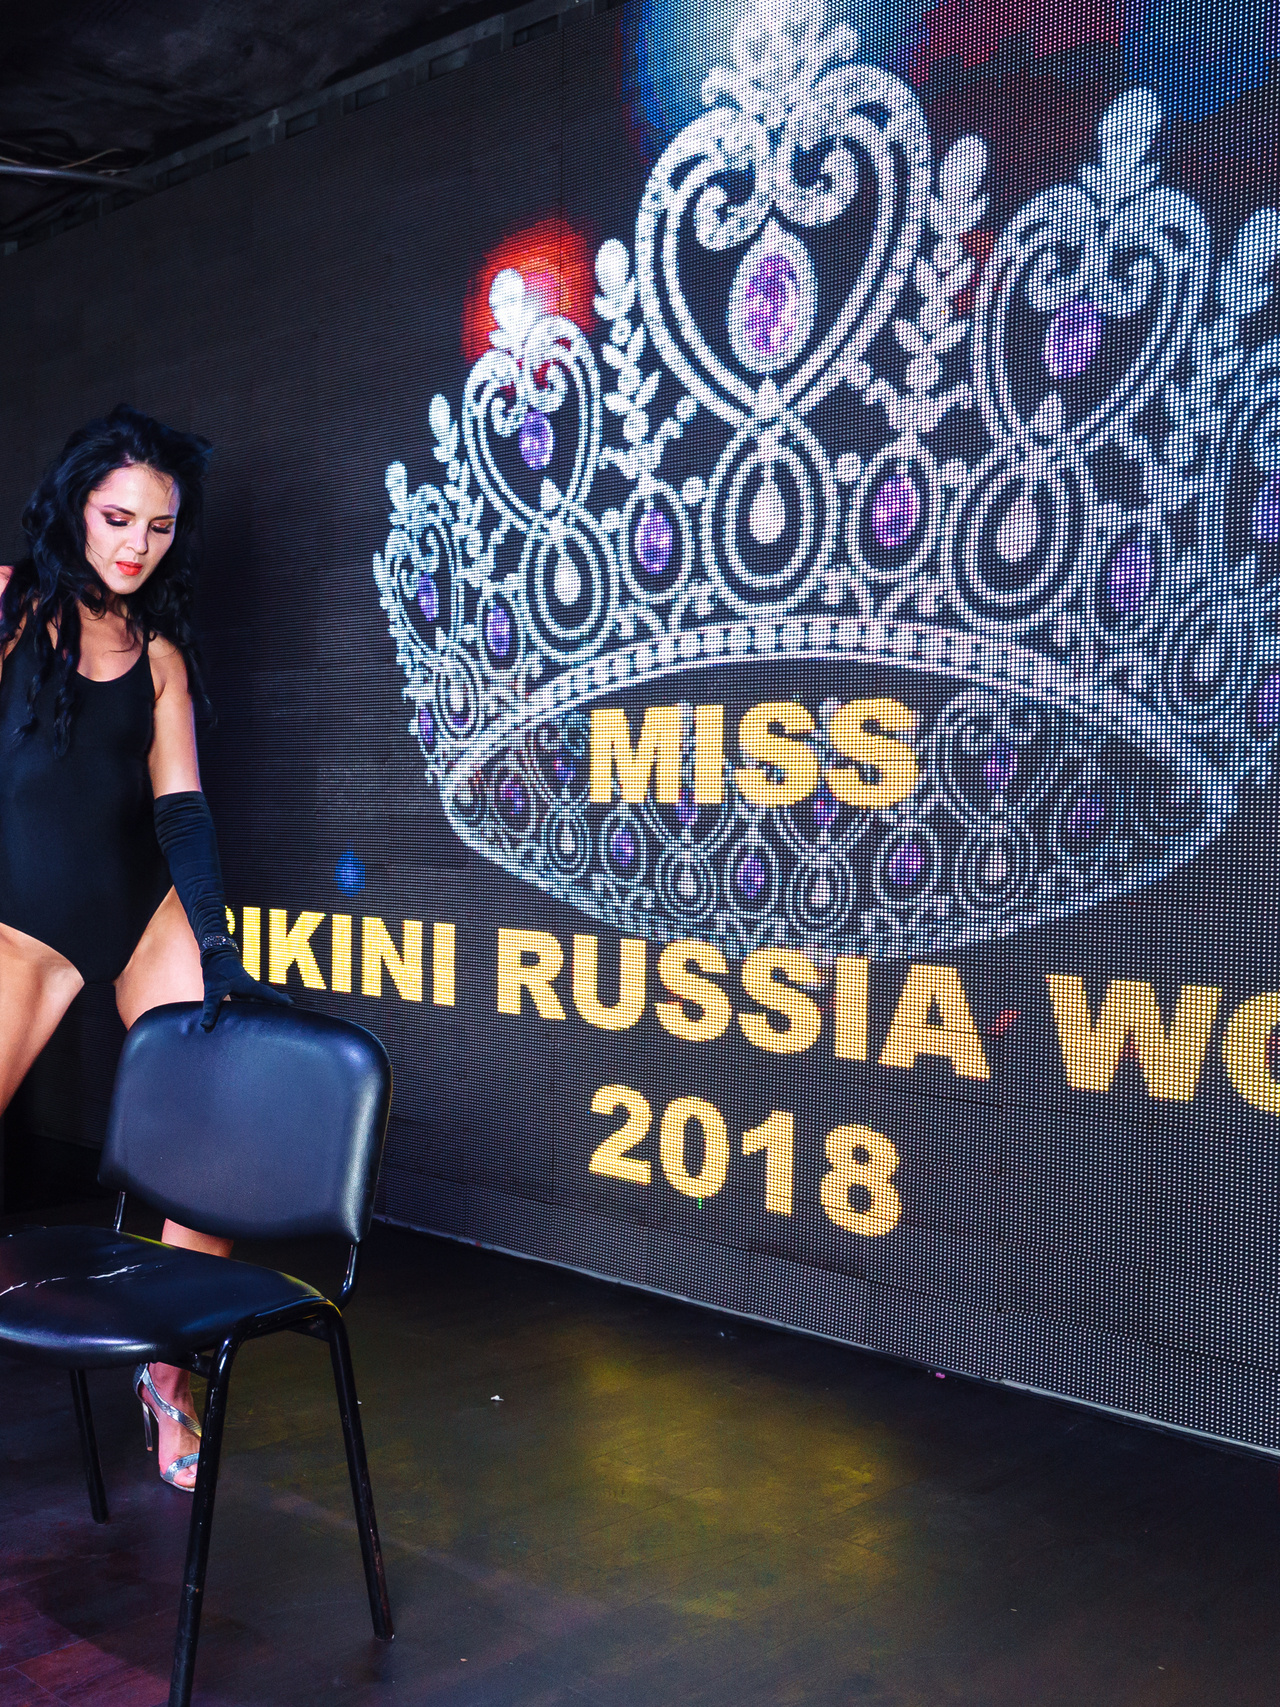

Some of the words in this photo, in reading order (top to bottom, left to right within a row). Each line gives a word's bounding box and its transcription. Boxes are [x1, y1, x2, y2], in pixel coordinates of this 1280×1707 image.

[589, 697, 920, 808] MISS
[225, 905, 456, 1007] IKINI
[496, 927, 992, 1080] RUSSIA
[588, 1083, 903, 1237] 2018
